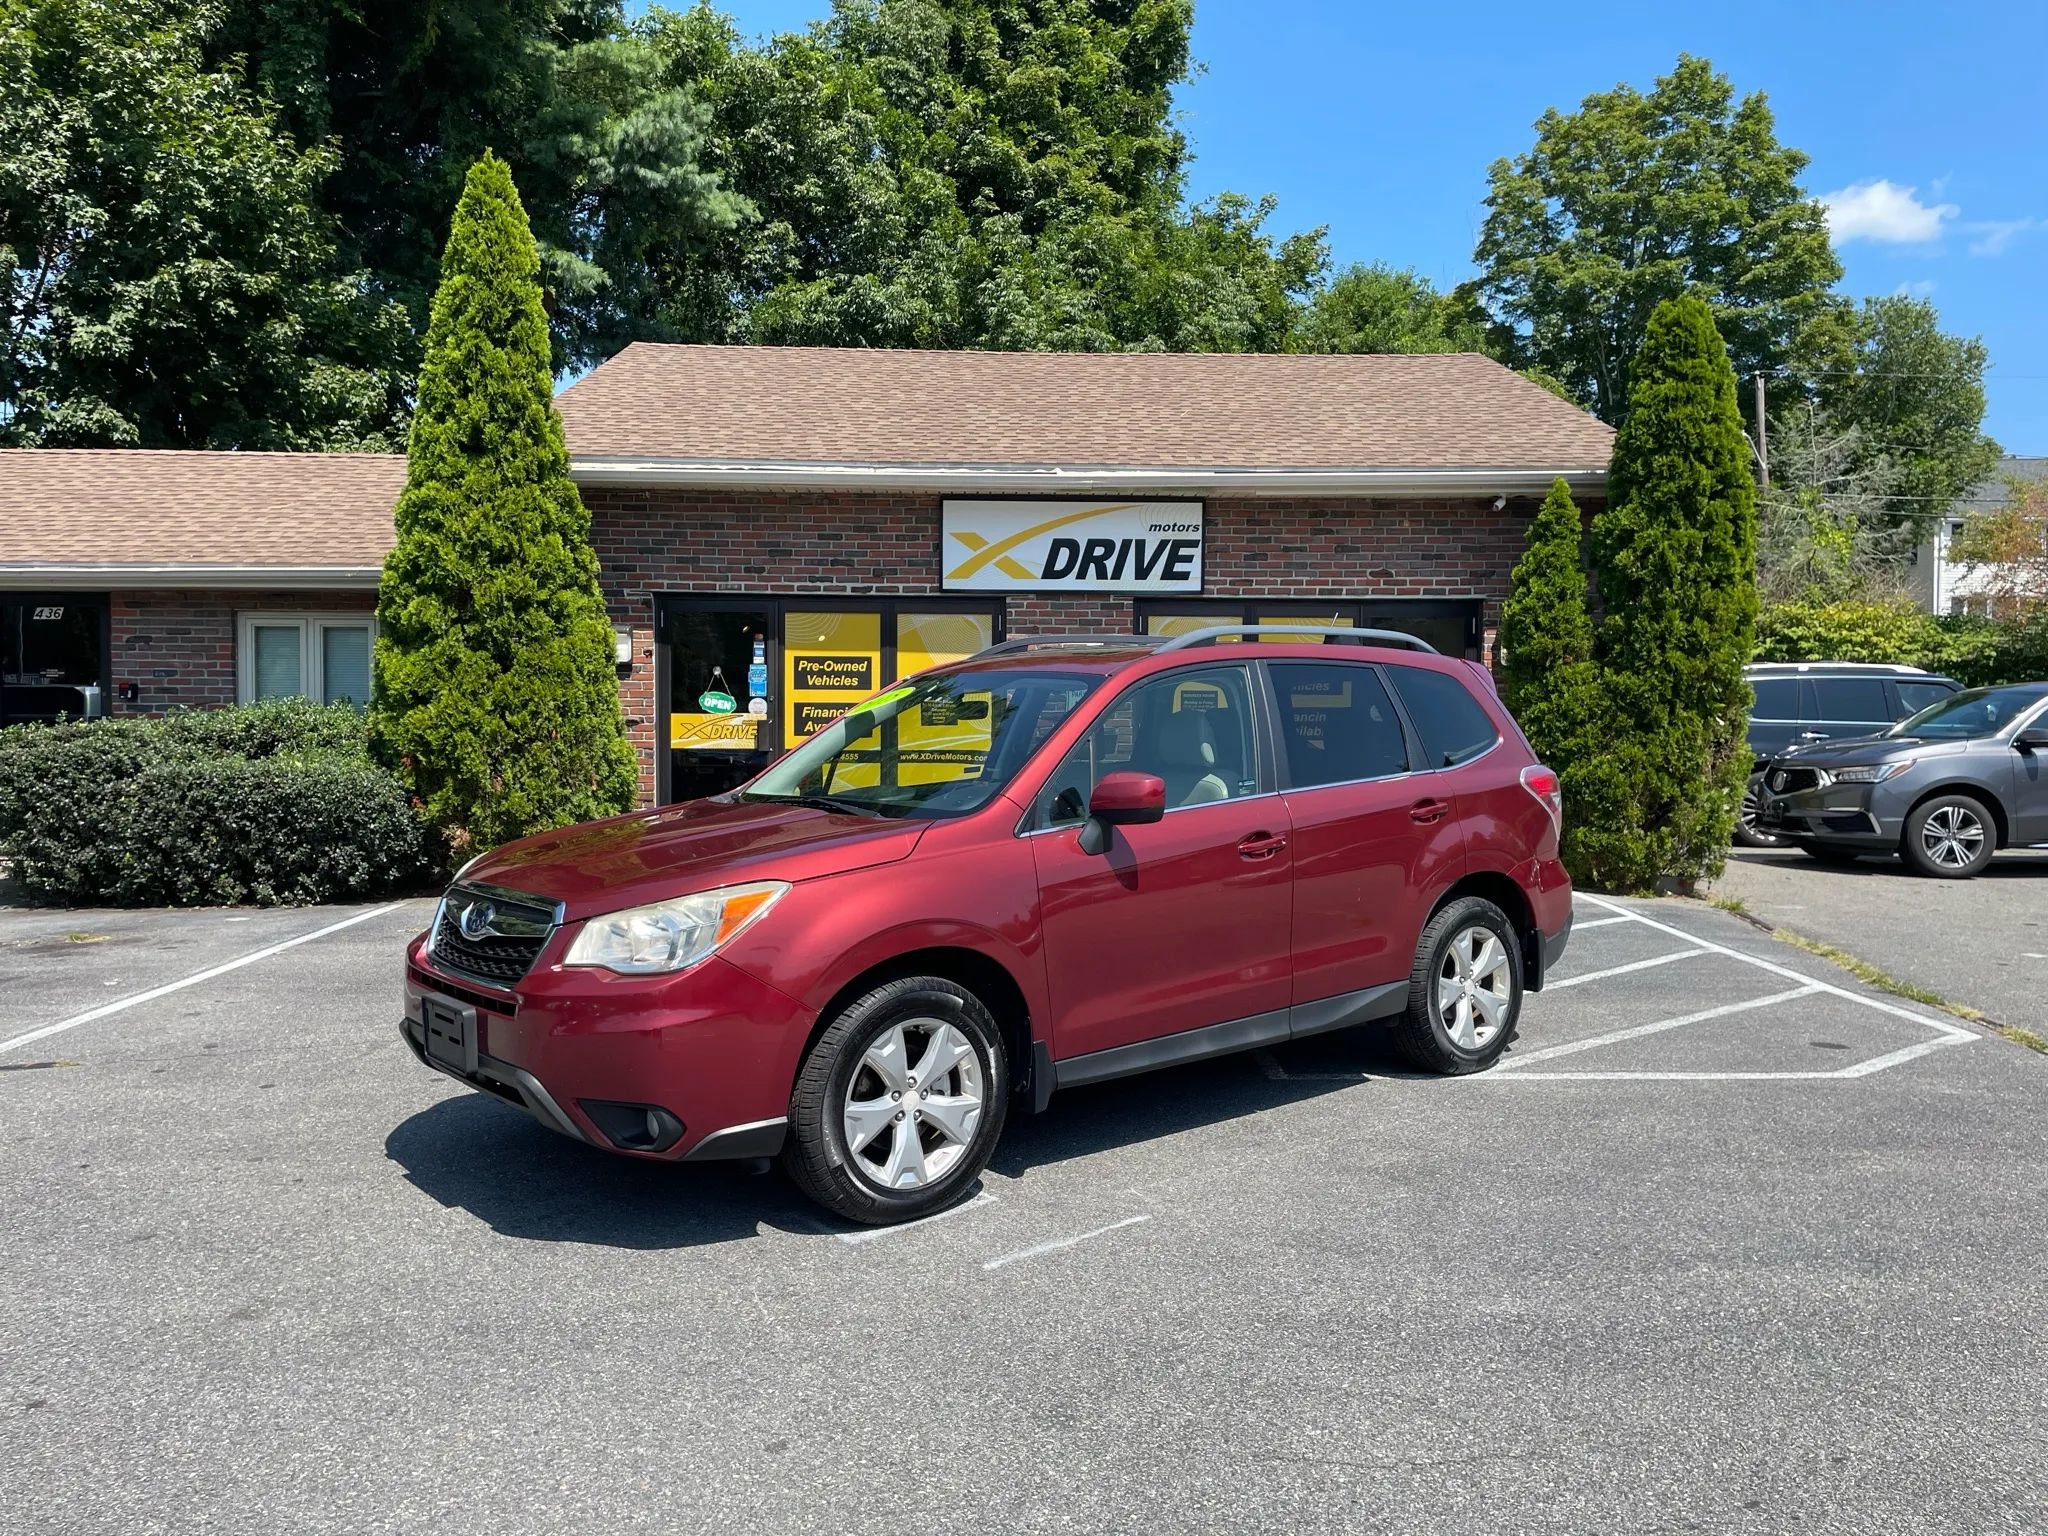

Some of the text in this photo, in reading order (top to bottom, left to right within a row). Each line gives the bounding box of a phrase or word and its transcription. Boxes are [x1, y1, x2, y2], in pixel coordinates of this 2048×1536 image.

[1148, 522, 1200, 532] motors
[35, 608, 61, 619] 436
[798, 660, 868, 672] Pre-Owned
[807, 675, 859, 686] Vehicles
[703, 697, 732, 711] OPEN
